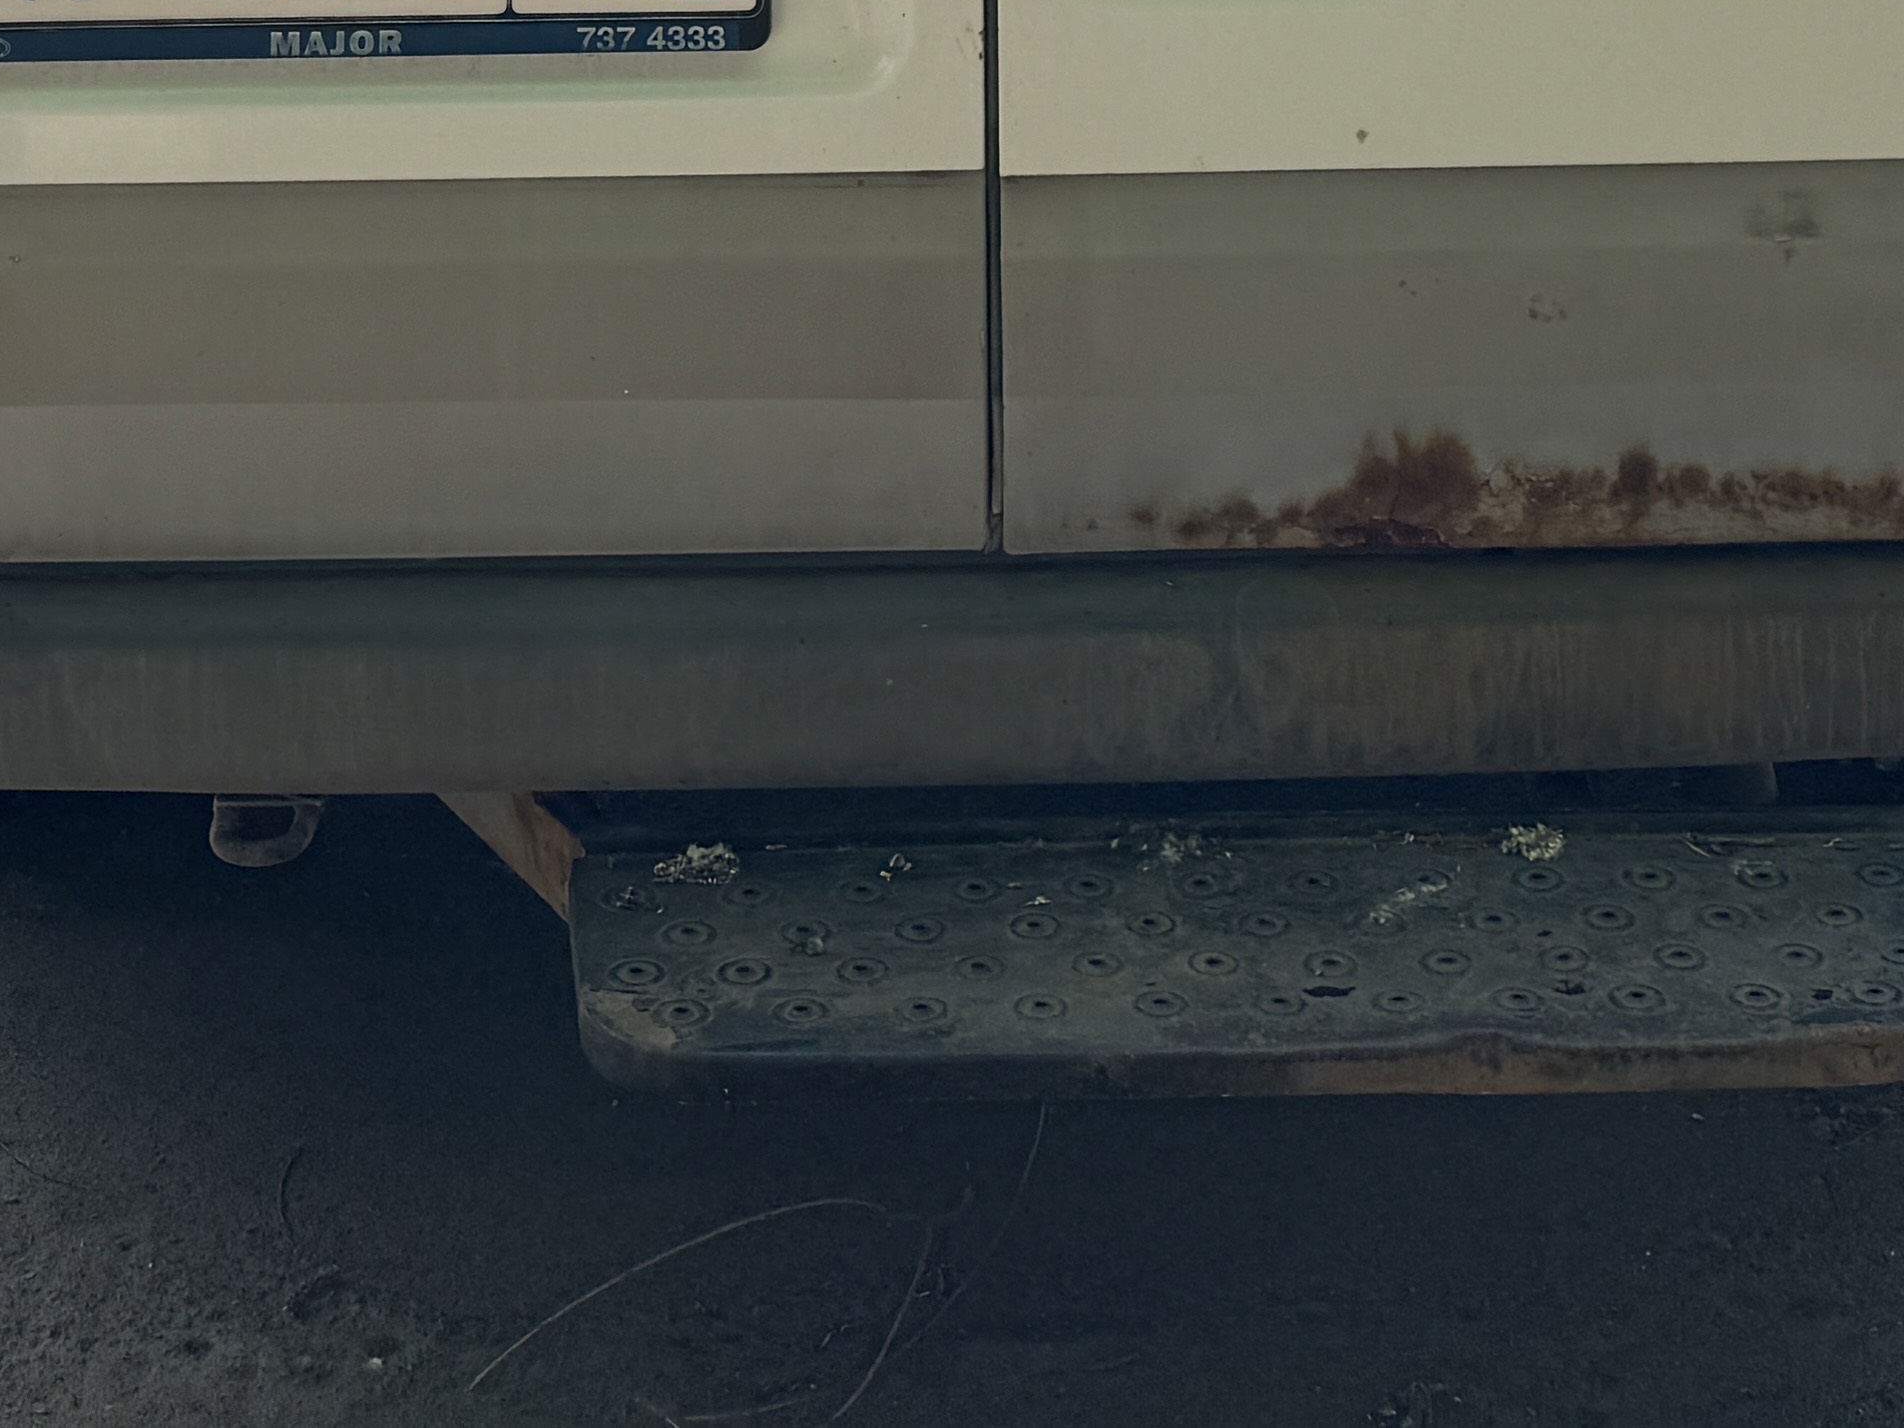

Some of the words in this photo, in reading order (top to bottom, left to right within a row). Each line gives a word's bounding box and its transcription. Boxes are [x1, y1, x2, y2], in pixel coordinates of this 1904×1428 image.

[269, 29, 404, 57] MAJOR
[576, 26, 636, 51] 737
[646, 25, 726, 50] 4333
